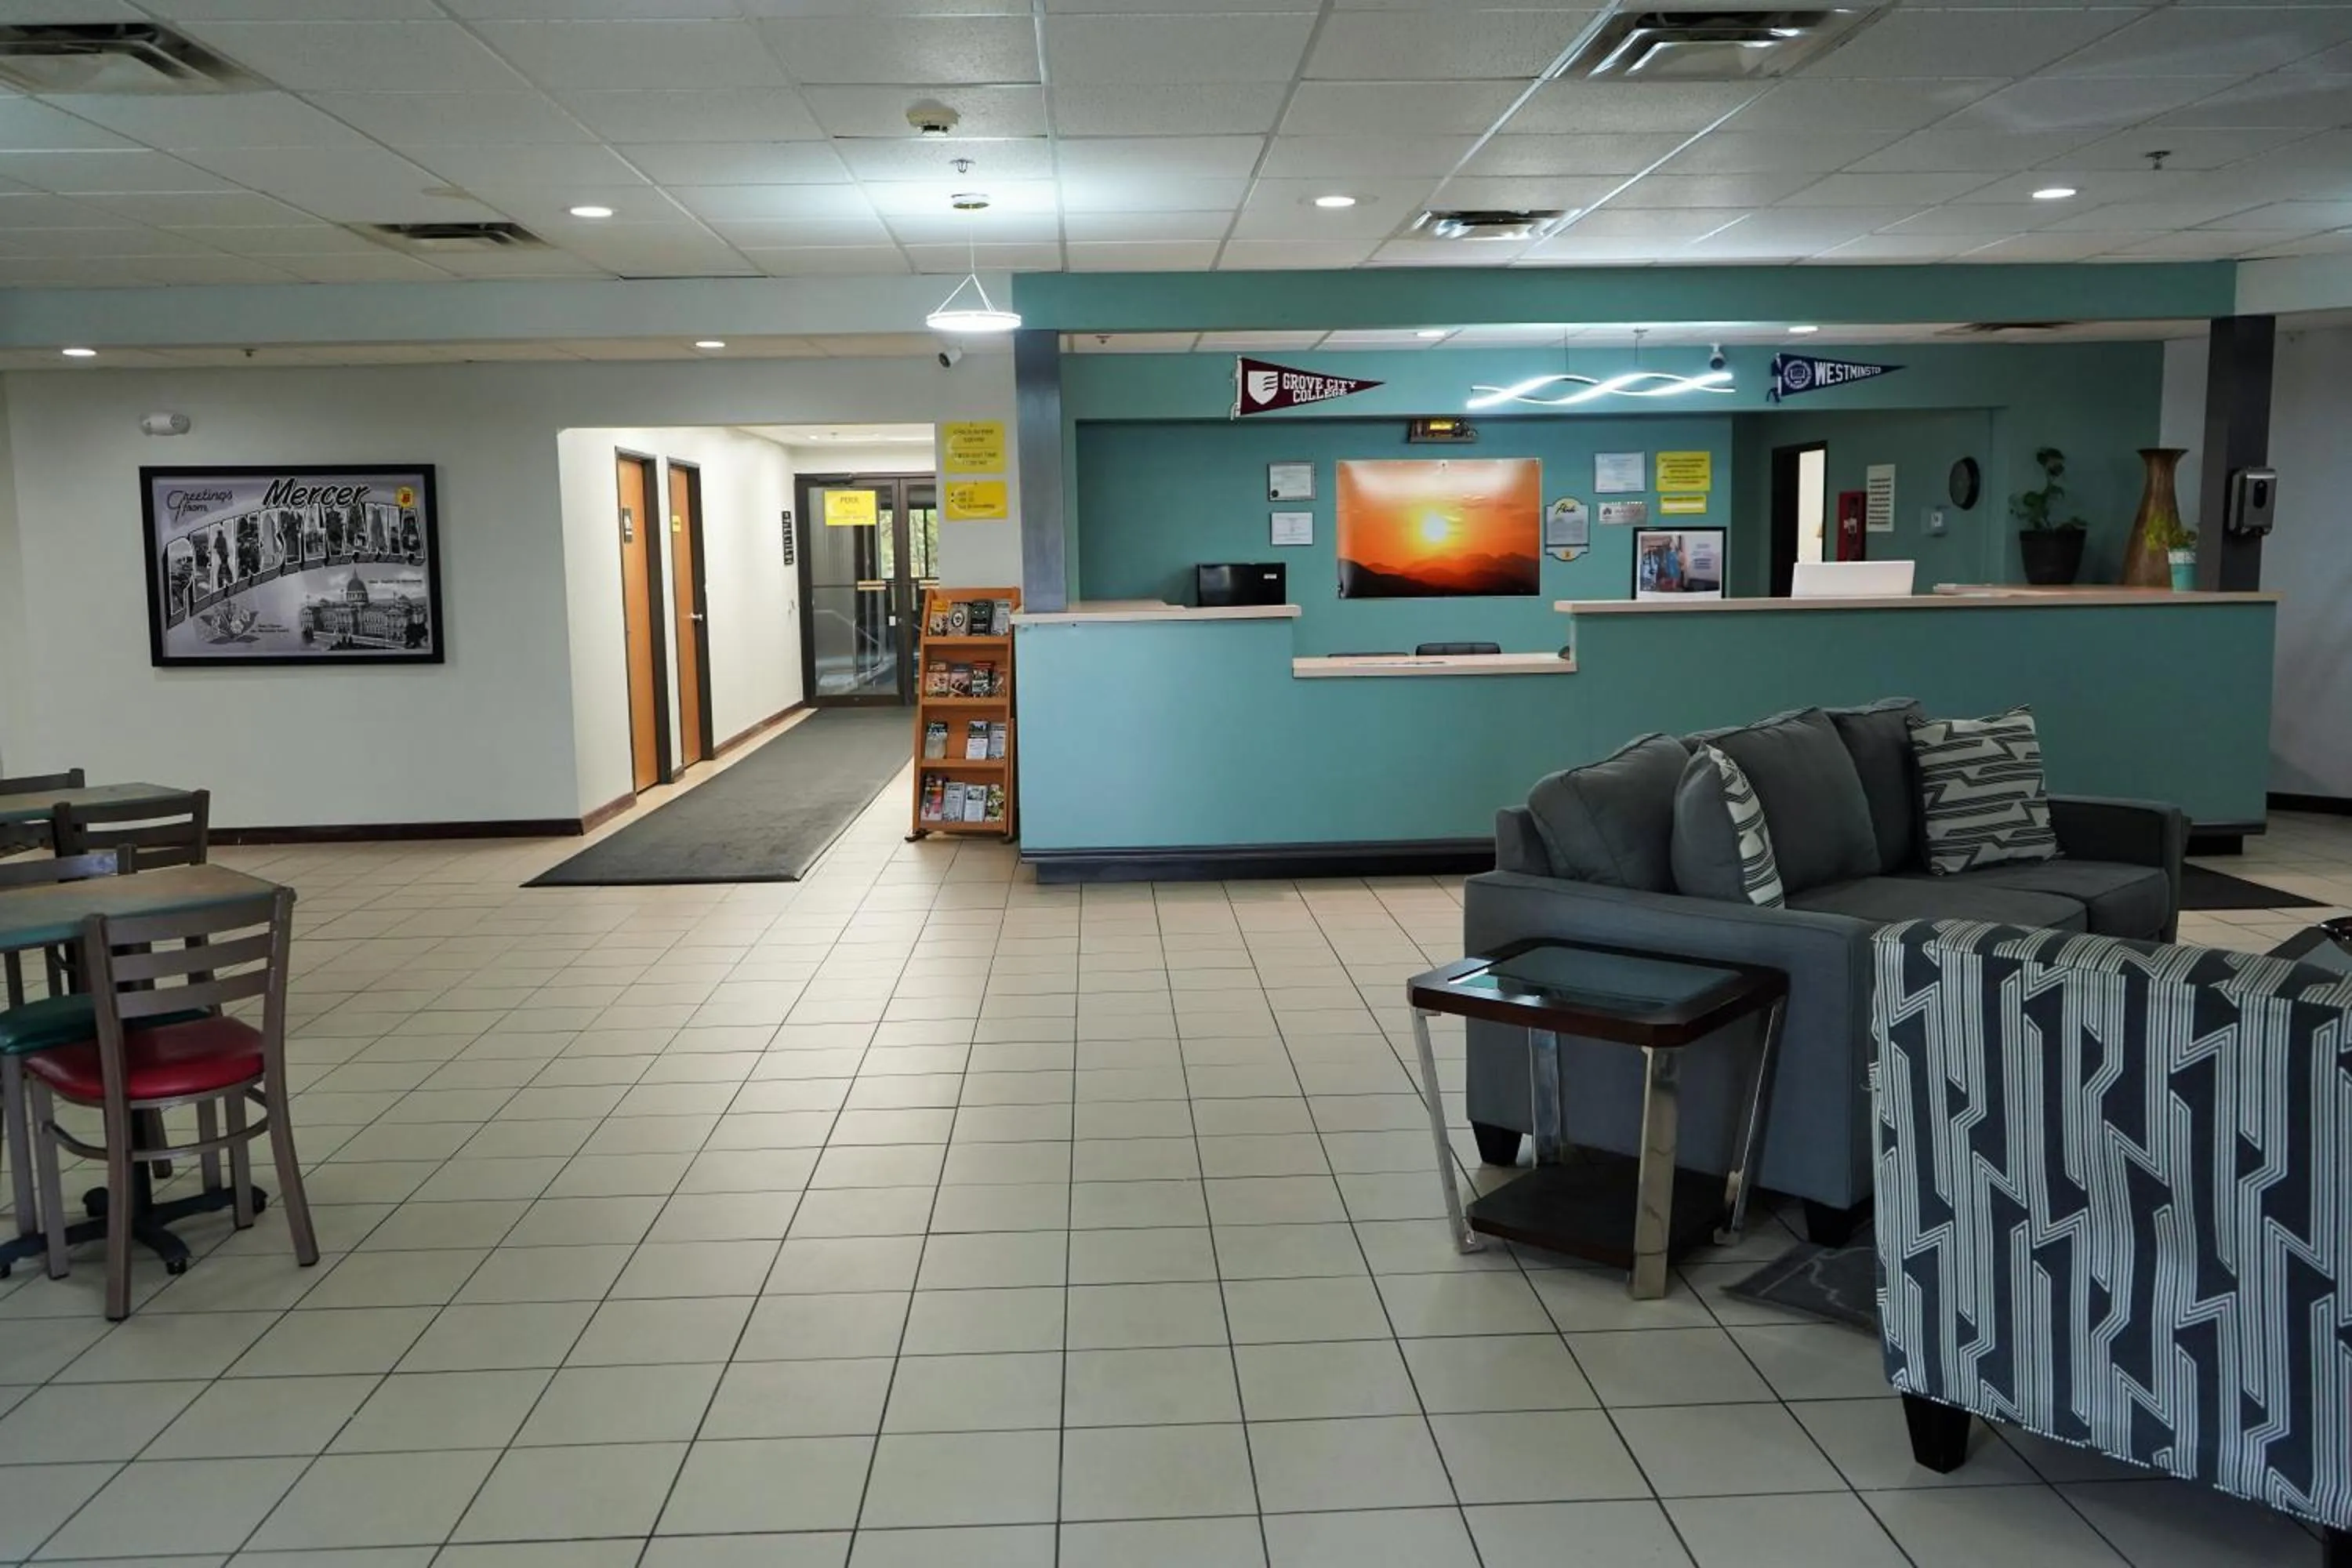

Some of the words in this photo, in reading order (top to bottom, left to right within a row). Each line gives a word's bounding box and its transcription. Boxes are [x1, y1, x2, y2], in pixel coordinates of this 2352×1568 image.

[1283, 372, 1323, 390] GROVE
[1327, 379, 1356, 390] CITY
[1293, 389, 1348, 403] COLLEGE
[263, 477, 370, 507] Mercer
[166, 489, 233, 515] Greetings
[180, 503, 209, 517] from
